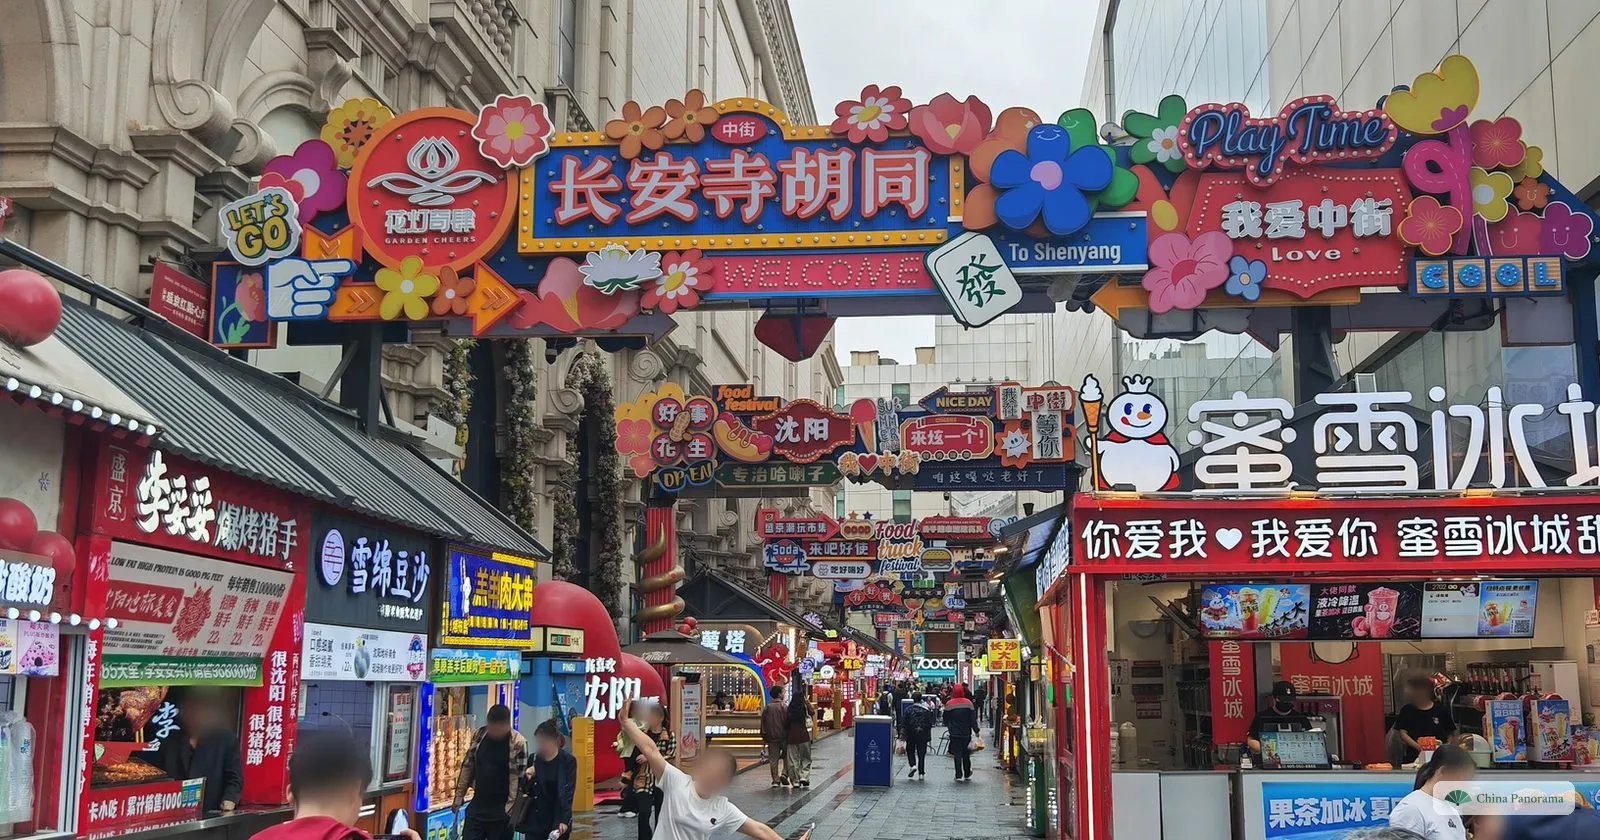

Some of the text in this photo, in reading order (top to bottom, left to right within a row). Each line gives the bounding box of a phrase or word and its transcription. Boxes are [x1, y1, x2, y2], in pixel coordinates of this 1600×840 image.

[722, 121, 756, 139] 中街
[1190, 103, 1386, 177] Play Time
[550, 147, 933, 226] 长安寺胡同
[227, 192, 287, 232] LET'S
[1221, 198, 1394, 239] 我爱中街
[236, 218, 288, 250] GO
[433, 236, 476, 244] CHEERS
[1009, 243, 1121, 264] To Shenyang
[1271, 246, 1341, 262] Love
[723, 256, 920, 288] WELCOME
[956, 253, 1007, 309] 發
[1421, 262, 1558, 289] COOL
[717, 386, 751, 401] food
[725, 398, 779, 411] festival
[936, 396, 993, 408] NICE DAY
[1027, 391, 1066, 410] 中街
[658, 403, 708, 423] 好事
[775, 415, 830, 443] 沈阳
[1036, 414, 1062, 458] 等你
[657, 438, 707, 459] 花生
[732, 465, 825, 483] 专治哈喇子
[839, 454, 858, 473] 我
[878, 451, 920, 474] 中街
[109, 454, 126, 514] 盛京
[664, 462, 713, 488] OPEN
[215, 501, 299, 562] 爆烤猪手
[875, 519, 917, 539] Food
[1082, 518, 1207, 560] 你爱我
[1251, 517, 1378, 558] 我爱你
[772, 544, 799, 556] Soda
[809, 542, 869, 556] 来吧好使
[878, 536, 923, 559] truck
[112, 556, 125, 568] LOW
[185, 568, 200, 579] GOOD
[351, 536, 430, 603] 雪绵豆沙
[830, 565, 865, 575] 吃好喝好
[880, 558, 920, 576] festival
[1316, 596, 1360, 610] 液冷降温
[998, 650, 1010, 661] 大
[1290, 674, 1374, 697] 蜜雪冰城
[264, 651, 287, 758] 很沈阳 很烧烤
[246, 714, 265, 766] 很猪蹄
[126, 791, 200, 817] 累计销售1000
[1269, 798, 1368, 829] 果茶加冰
